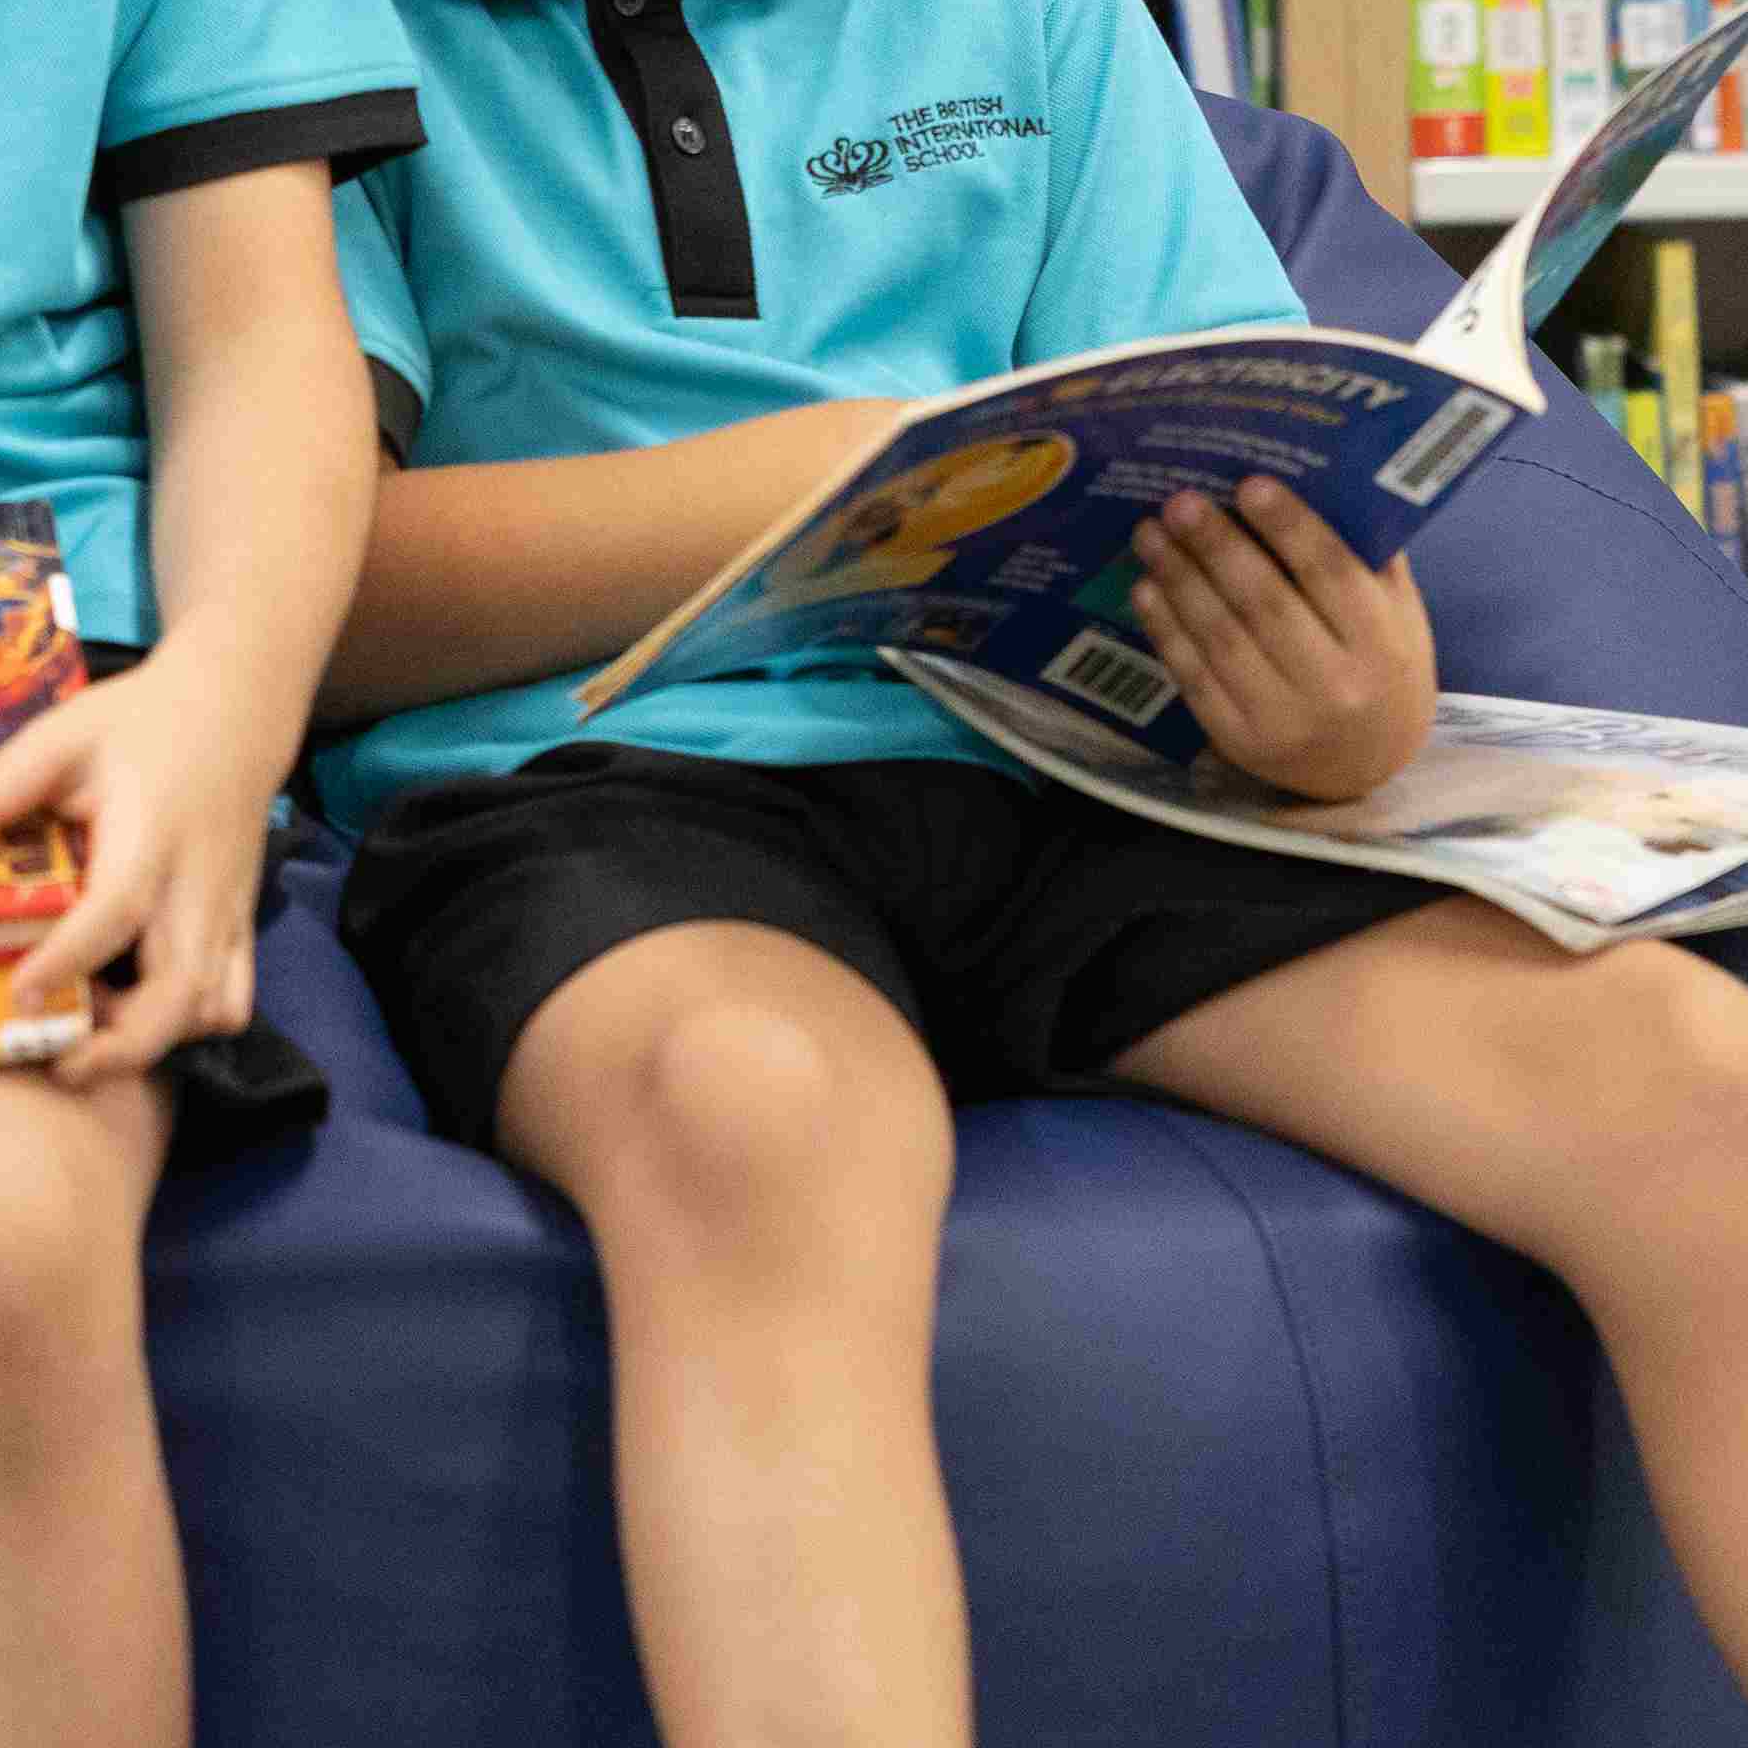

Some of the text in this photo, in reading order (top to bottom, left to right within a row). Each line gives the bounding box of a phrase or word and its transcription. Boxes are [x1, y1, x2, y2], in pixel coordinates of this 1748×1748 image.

[887, 95, 1005, 132] THE BRITISH
[893, 116, 1052, 155] INTERNATIONAL
[903, 140, 986, 173] SCHOOL
